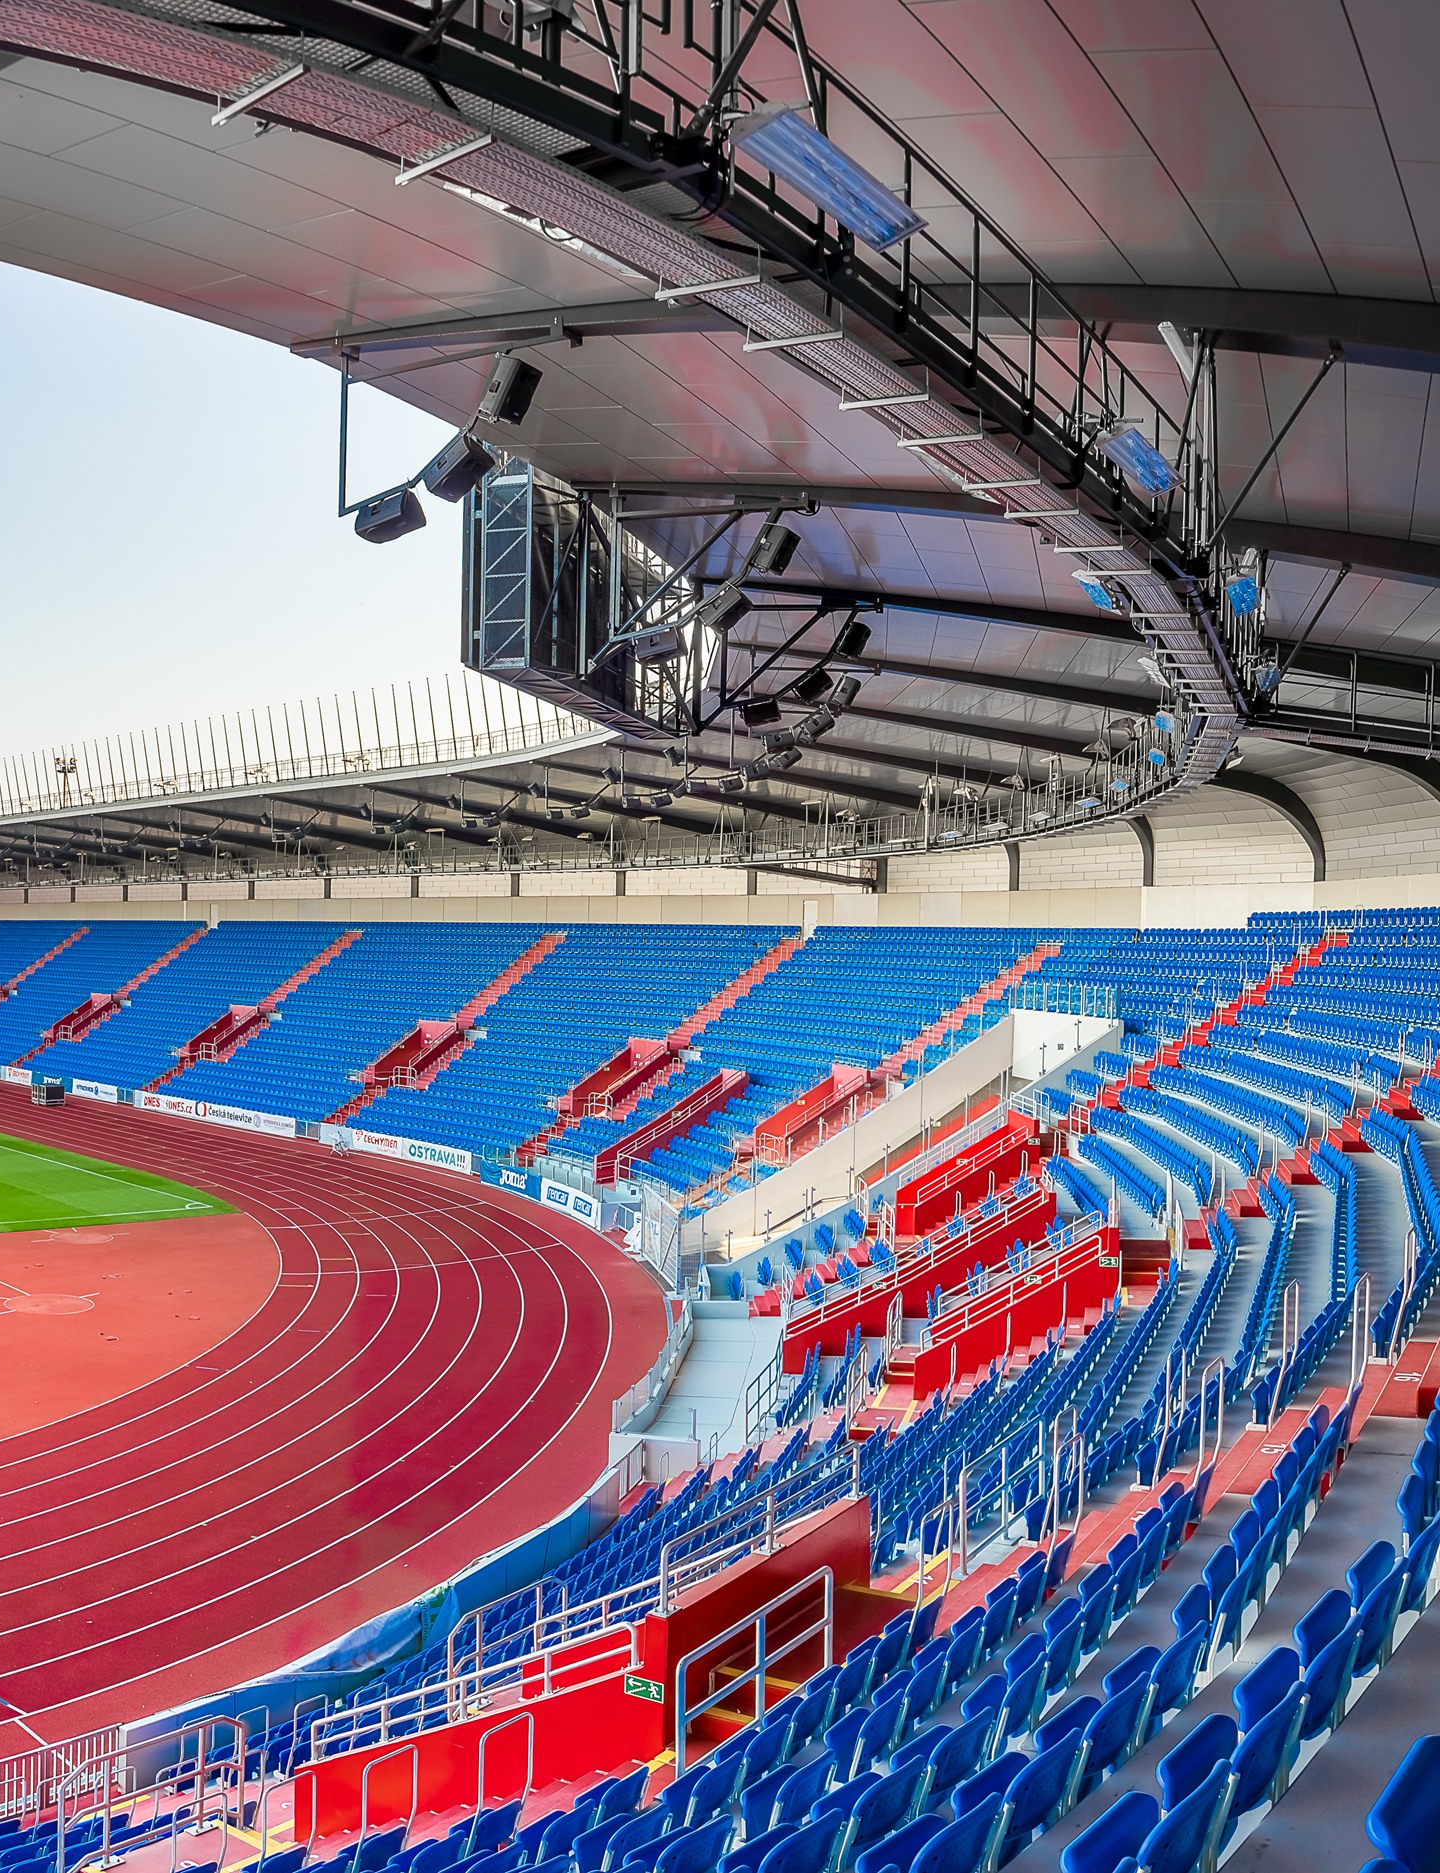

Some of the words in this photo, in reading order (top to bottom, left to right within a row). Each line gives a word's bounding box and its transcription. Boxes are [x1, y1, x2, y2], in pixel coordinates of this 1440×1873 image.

[143, 1096, 161, 1108] DNES
[208, 1104, 226, 1119] Česká
[227, 1109, 252, 1123] televize
[408, 1143, 466, 1169] OSTRAVA!!!
[547, 1187, 568, 1205] rencar
[574, 1197, 592, 1216] rencar
[1393, 1372, 1423, 1383] 16
[1261, 1443, 1288, 1454] 15
